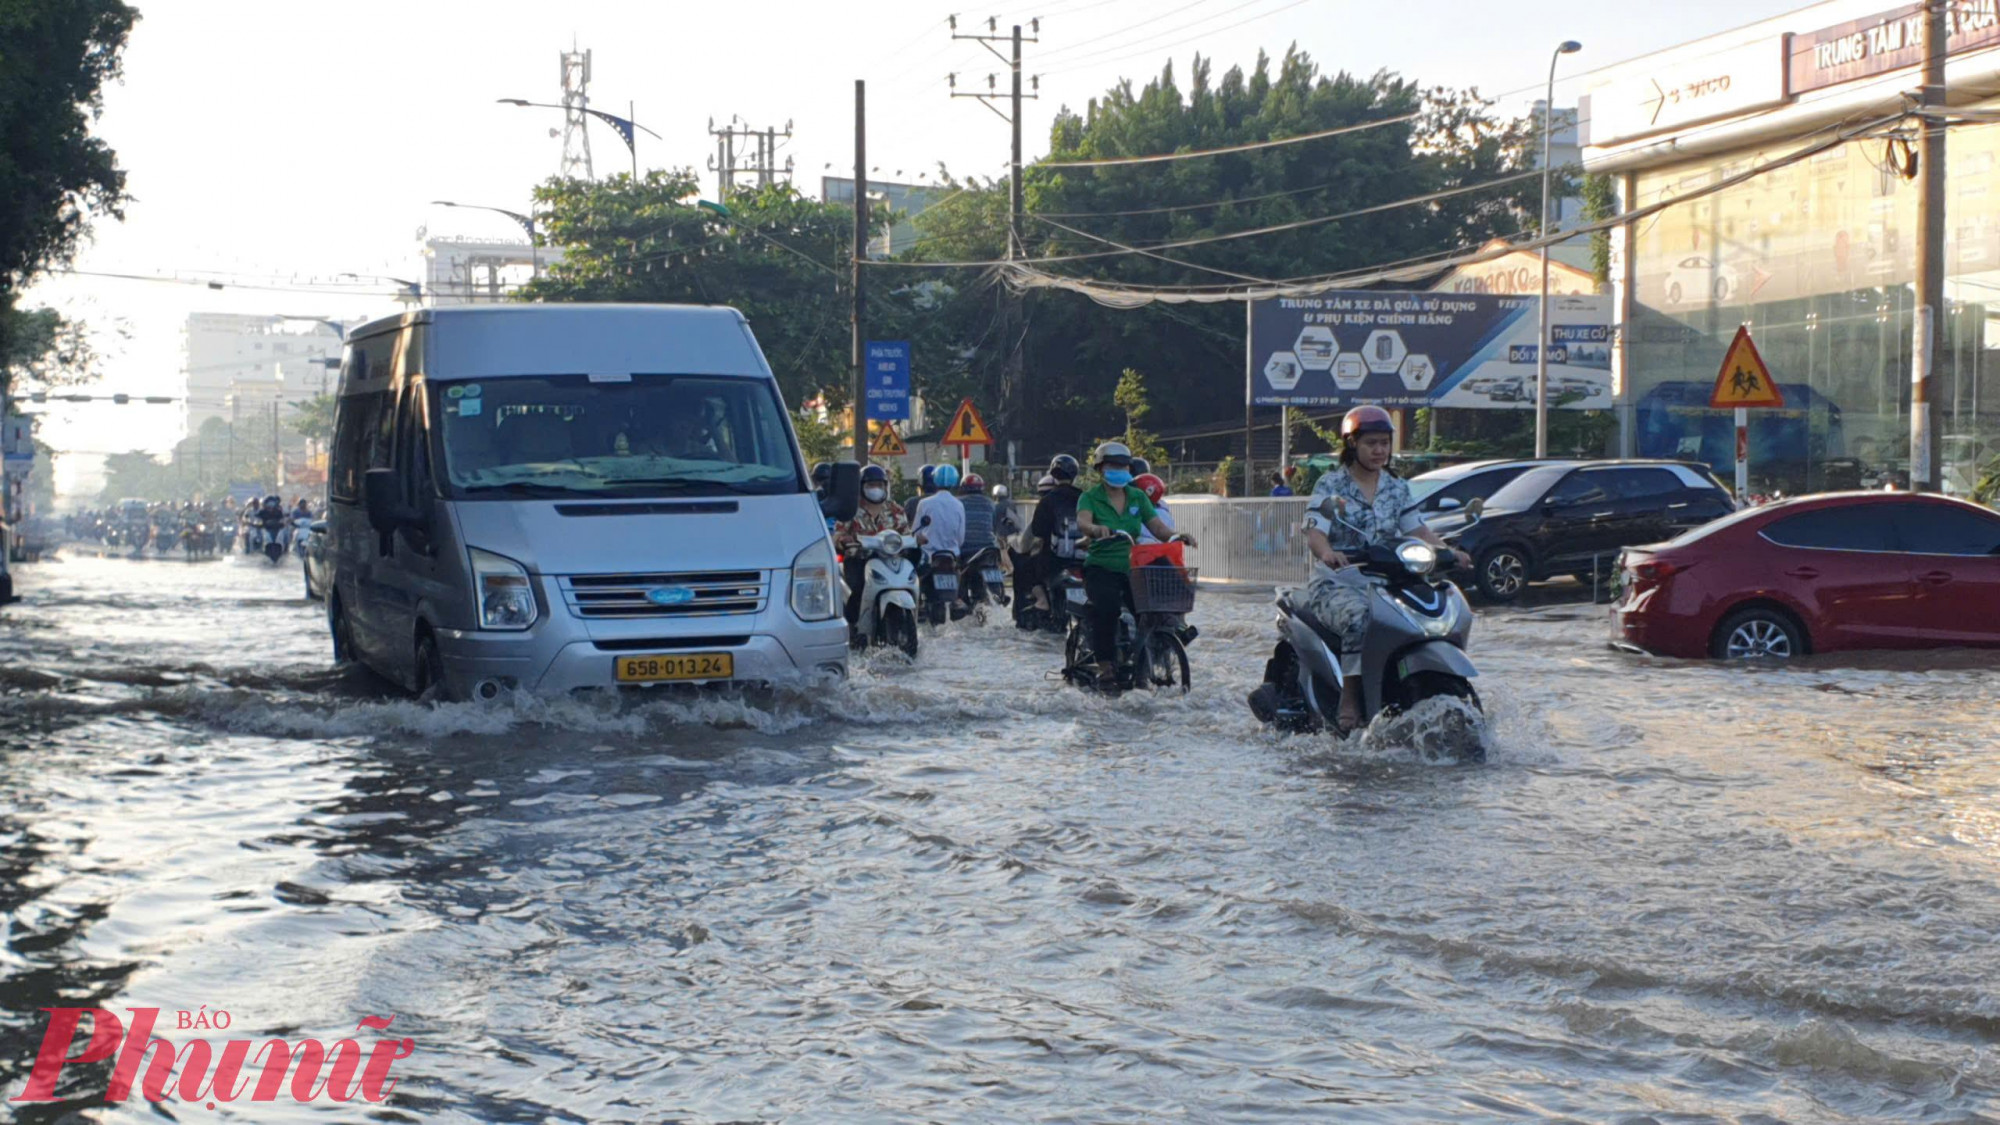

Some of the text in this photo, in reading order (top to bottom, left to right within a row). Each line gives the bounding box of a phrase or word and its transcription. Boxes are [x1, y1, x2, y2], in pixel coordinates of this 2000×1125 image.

[1813, 32, 1865, 69] TRUNG
[1279, 298, 1323, 309] TRUNG
[1325, 297, 1352, 310] TÂM
[1354, 300, 1371, 311] XE
[1374, 299, 1391, 311] ĐÃ
[1394, 300, 1420, 312] QUA
[1441, 301, 1477, 314] DỤNG
[1316, 313, 1342, 326] PHỤ
[1344, 312, 1375, 326] KIỆN
[1377, 312, 1415, 325] CHÍNH
[1554, 326, 1606, 340] THU XE CŨ
